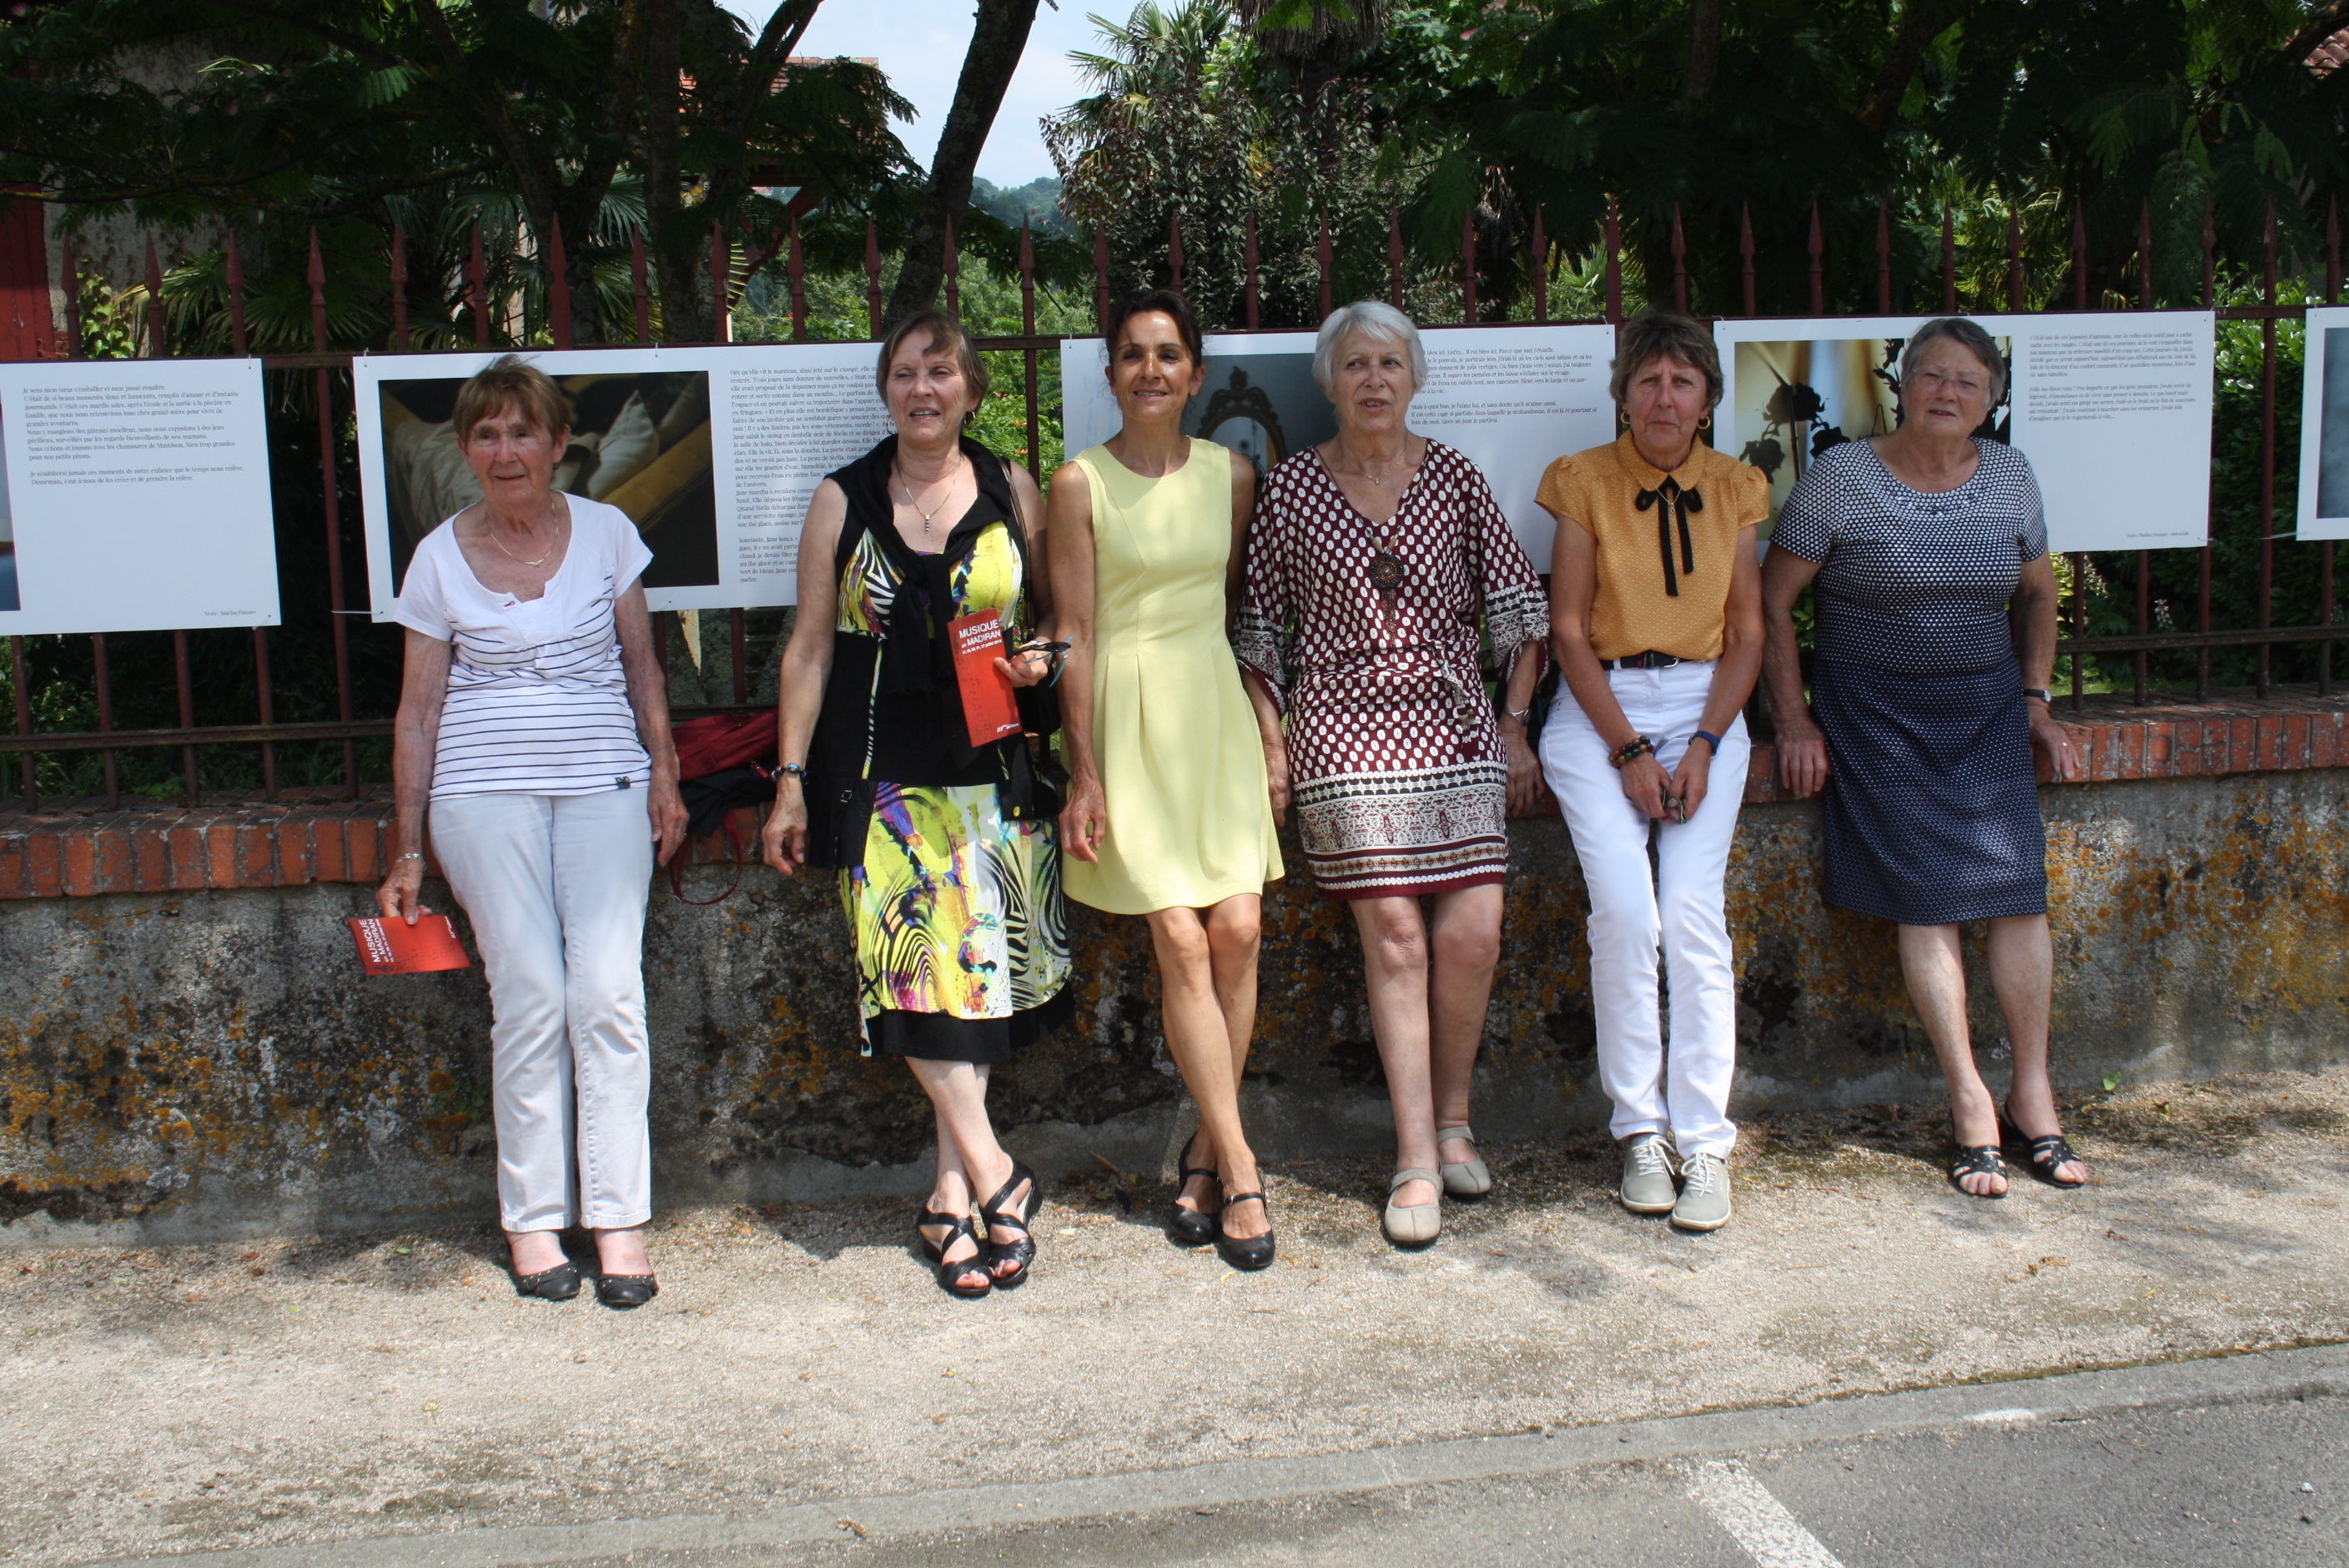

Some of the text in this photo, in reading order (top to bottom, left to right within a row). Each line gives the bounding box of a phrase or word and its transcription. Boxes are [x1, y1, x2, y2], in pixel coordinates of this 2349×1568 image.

[959, 619, 998, 638] MUSIQUE
[967, 630, 1001, 646] MADIRAN
[359, 918, 380, 962] MUSIQUE
[367, 918, 386, 954] MADIRAN
